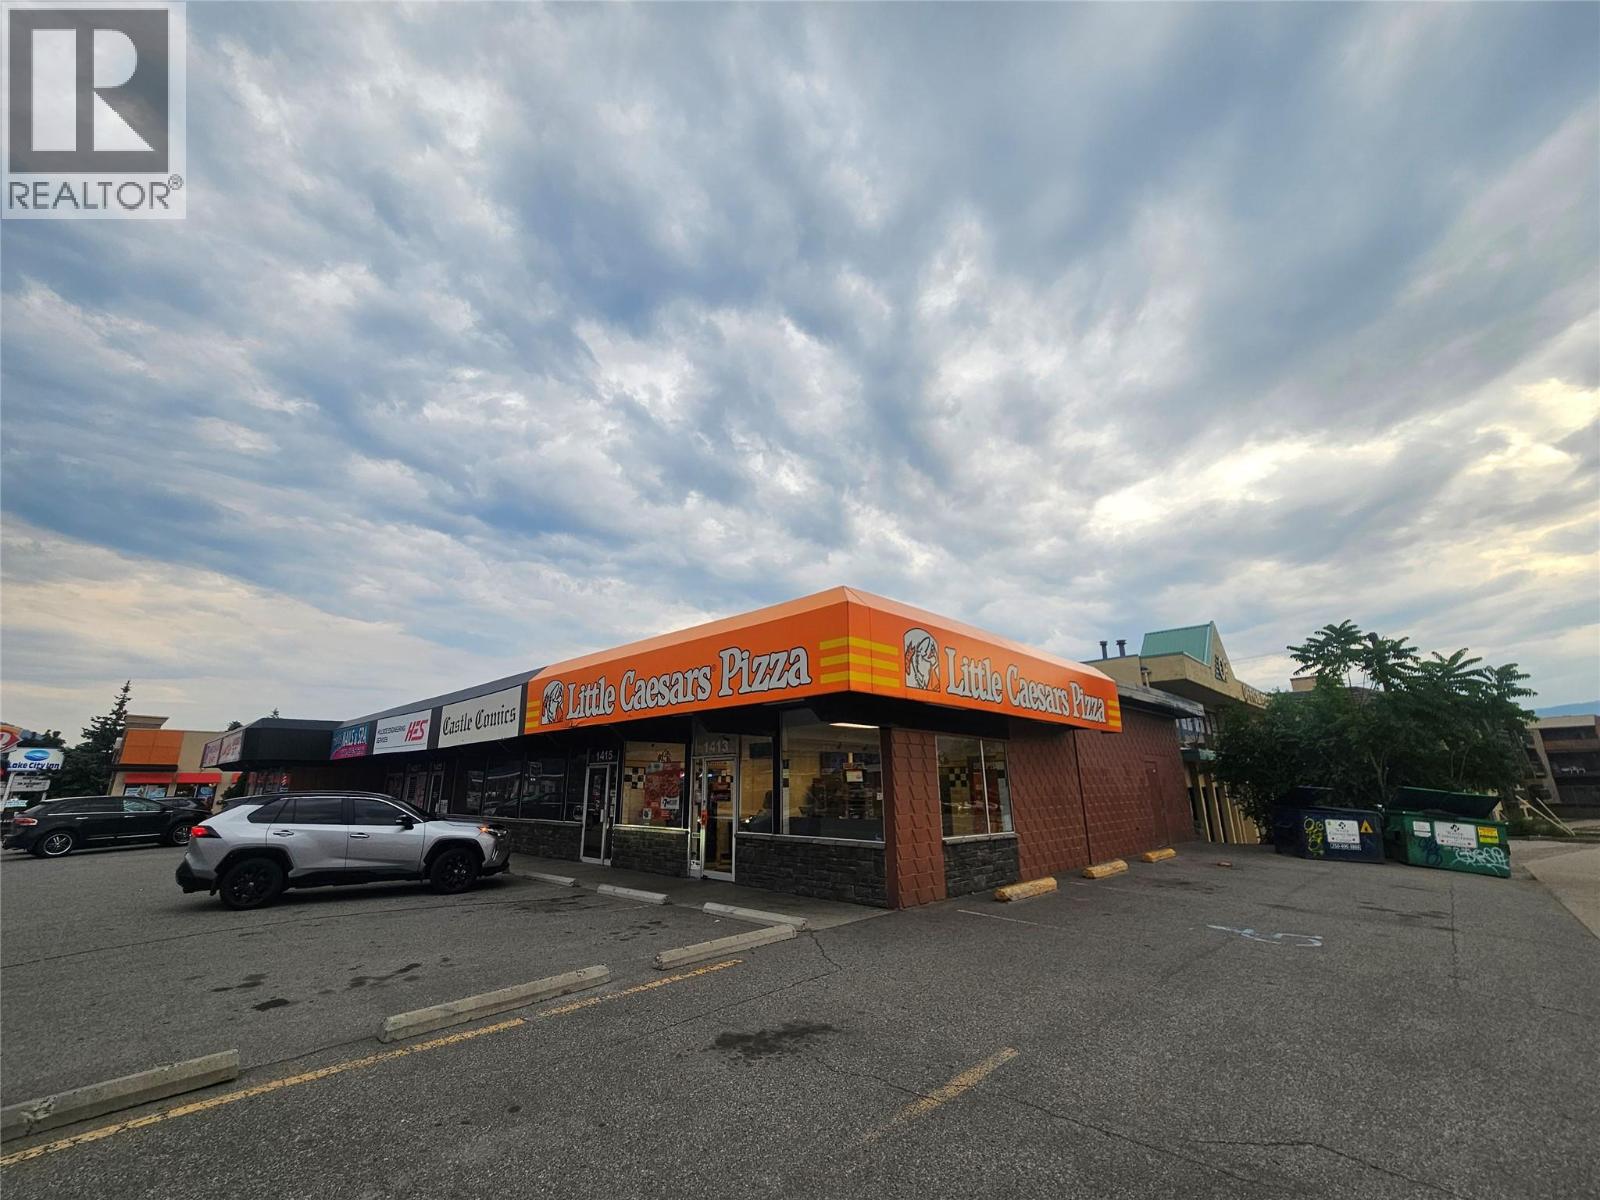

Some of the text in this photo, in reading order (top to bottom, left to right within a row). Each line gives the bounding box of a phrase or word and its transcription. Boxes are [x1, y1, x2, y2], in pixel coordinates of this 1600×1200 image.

[566, 646, 811, 720] Little Caesars Pizza
[944, 647, 1106, 723] Little Caesars Pizza
[442, 704, 516, 736] Castle Comics
[595, 750, 613, 762] 1415
[704, 740, 729, 753] 1413
[29, 761, 46, 770] City
